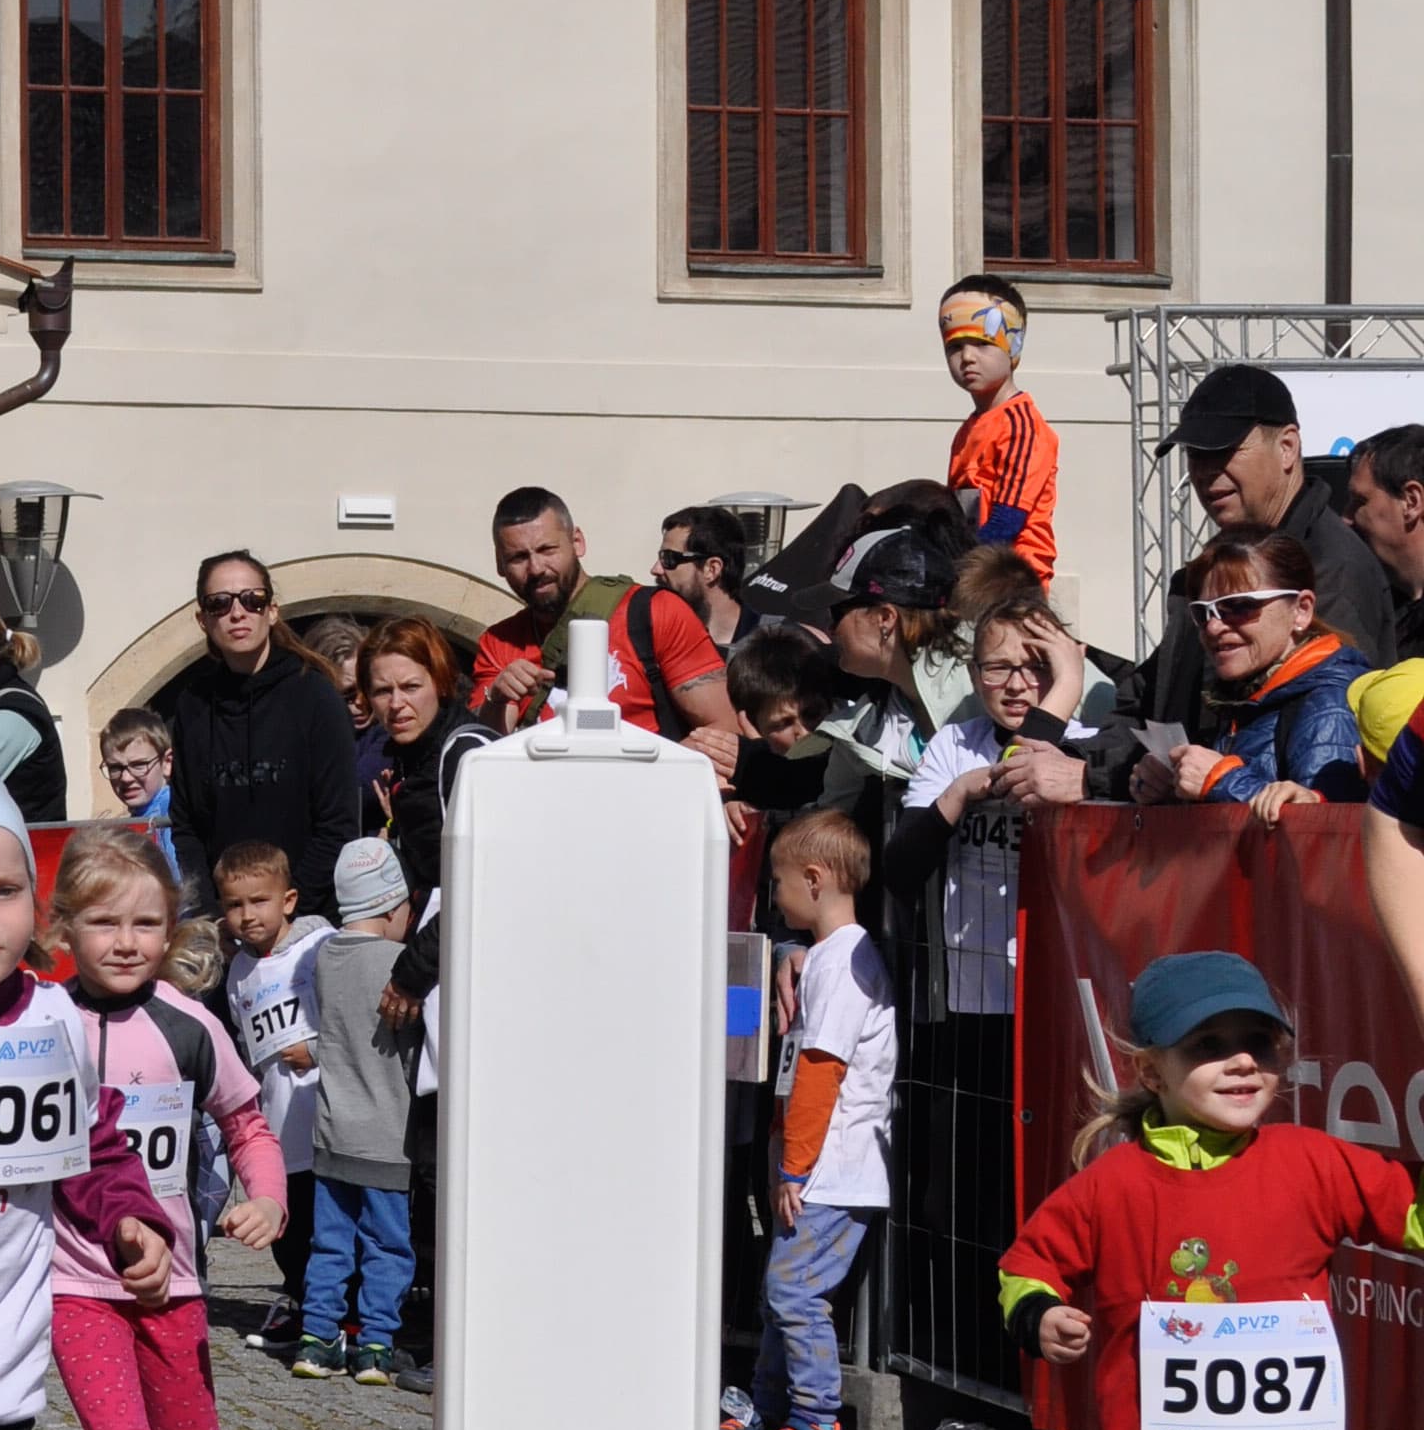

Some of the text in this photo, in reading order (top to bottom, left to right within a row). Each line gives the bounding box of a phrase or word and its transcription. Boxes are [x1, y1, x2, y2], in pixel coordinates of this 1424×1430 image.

[250, 996, 301, 1043] 5117
[18, 1038, 56, 1055] PVZP
[1238, 1315, 1280, 1330] PVZP
[1163, 1355, 1326, 1415] 5087
